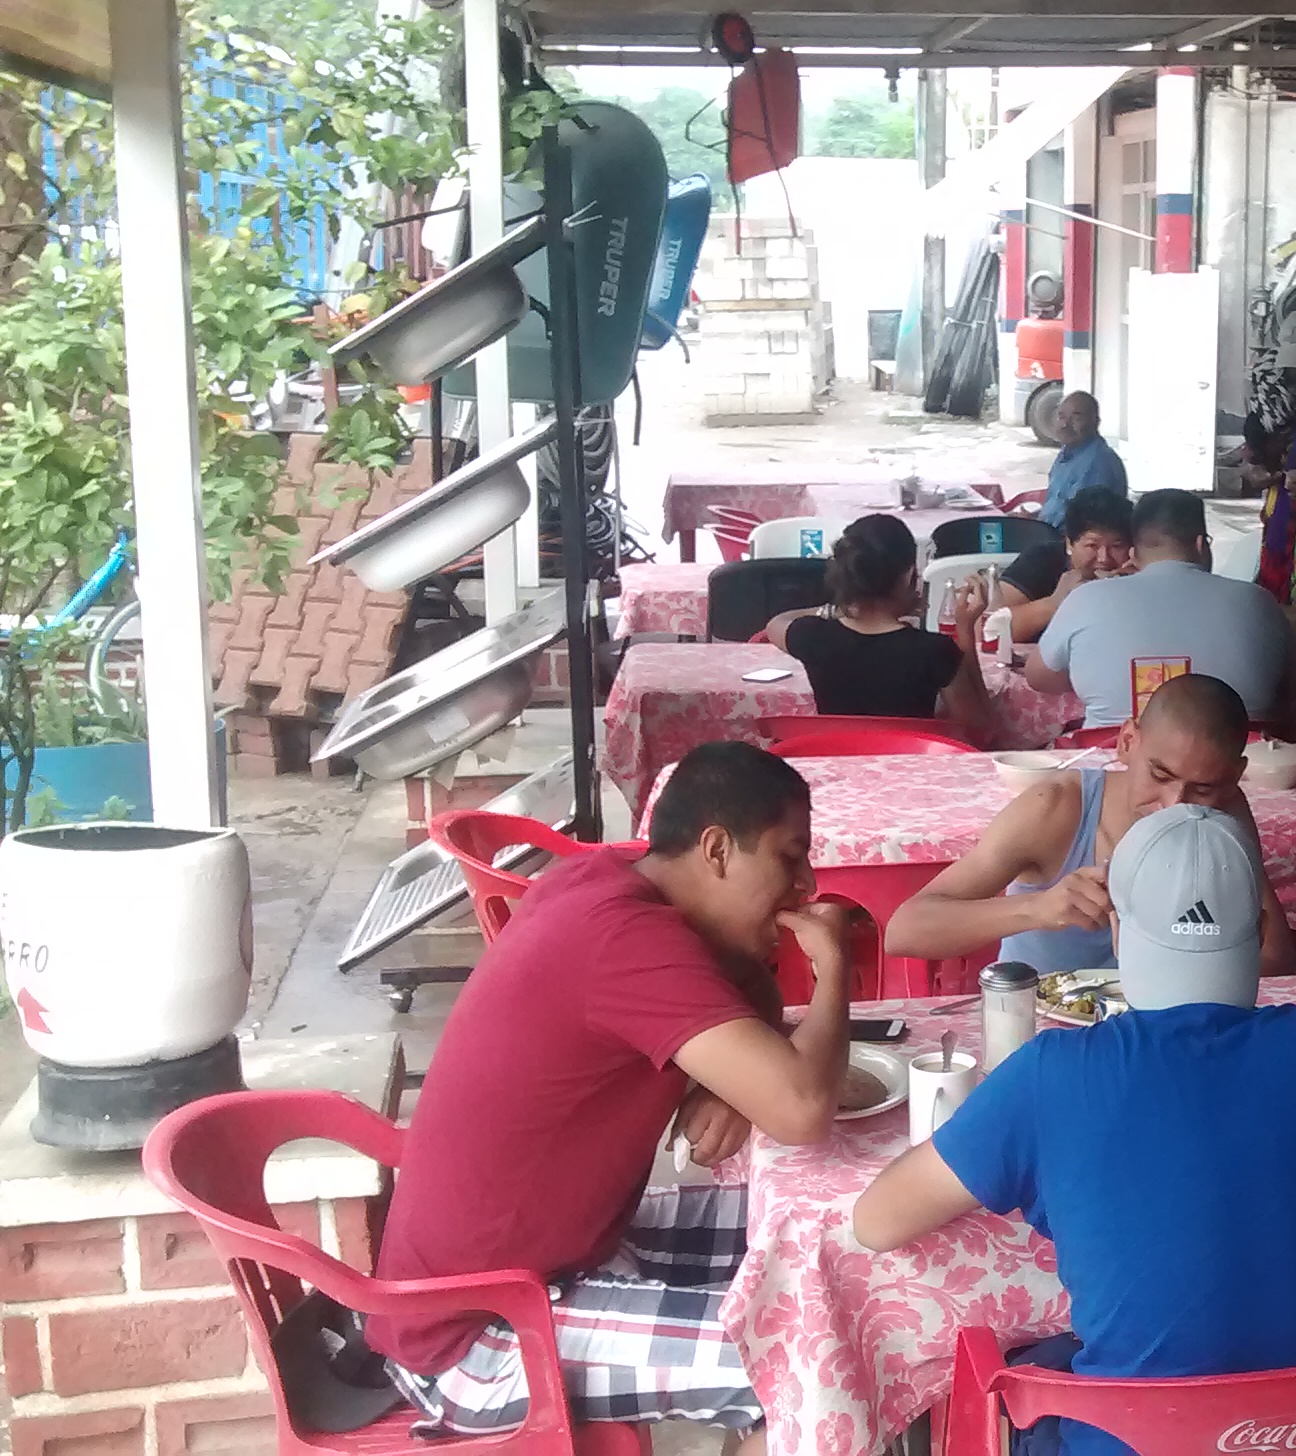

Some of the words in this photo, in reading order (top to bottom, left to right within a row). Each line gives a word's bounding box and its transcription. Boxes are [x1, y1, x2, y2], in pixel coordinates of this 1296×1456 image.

[597, 217, 628, 317] TRUPER
[659, 238, 682, 300] TRUPER
[1171, 921, 1221, 936] adidas
